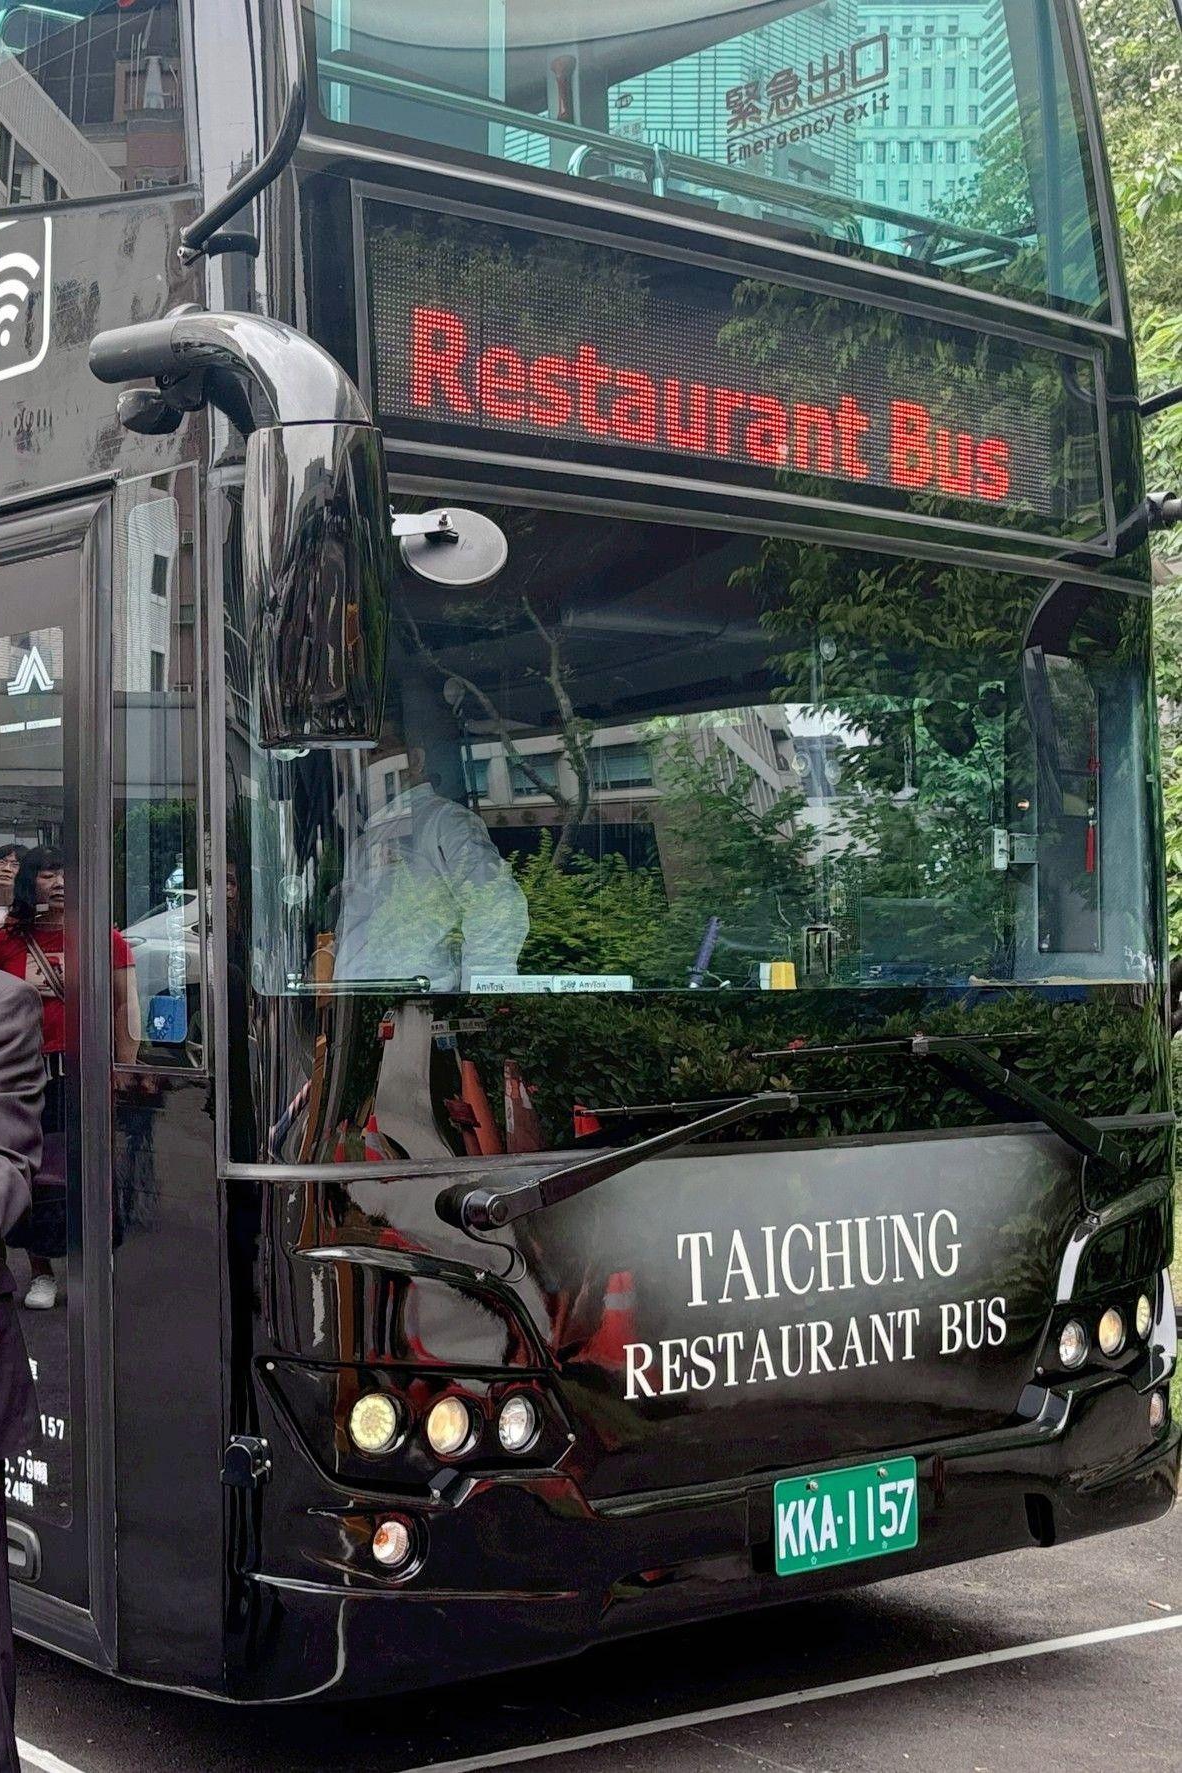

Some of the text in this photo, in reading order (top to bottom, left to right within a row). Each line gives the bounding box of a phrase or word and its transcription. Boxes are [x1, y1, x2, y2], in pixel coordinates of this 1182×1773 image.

[726, 33, 889, 133] 緊急出口
[727, 92, 890, 165] Emergency exit
[413, 306, 1011, 501] Restaurant Bus
[677, 1209, 962, 1307] TAICHUNG
[623, 1297, 1006, 1400] RESTAURANT BUS
[777, 1478, 915, 1560] KKA-1157
